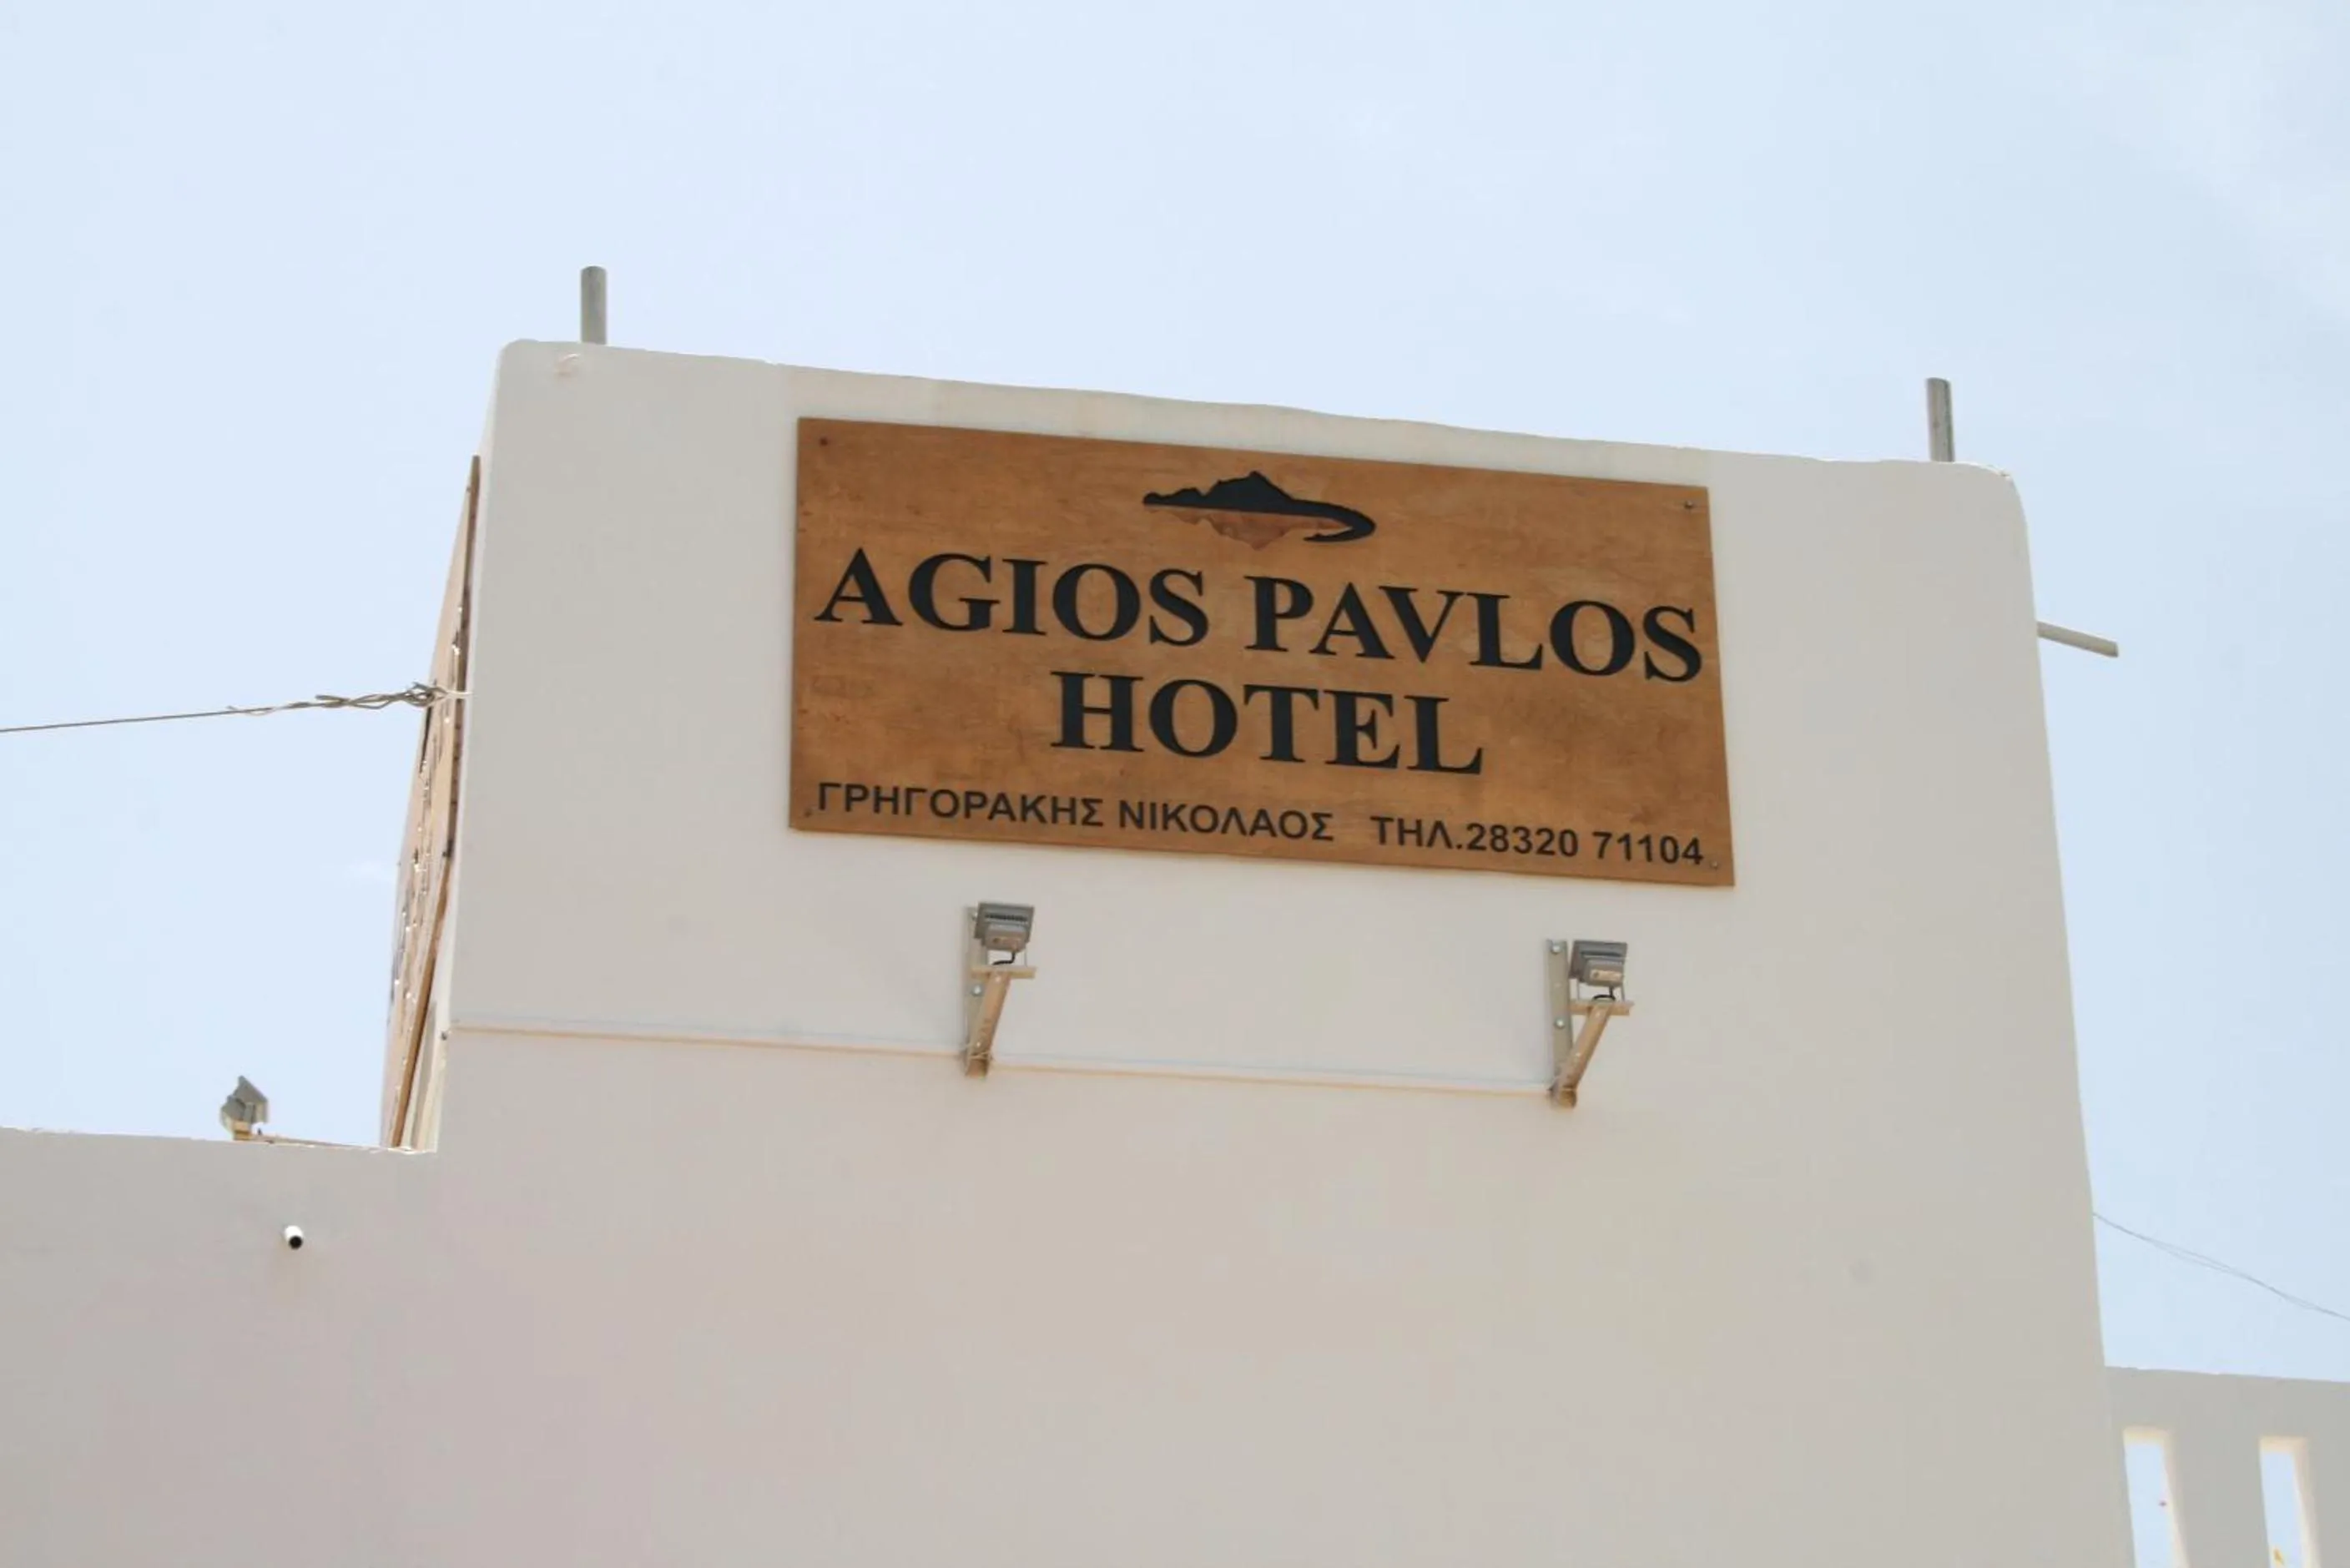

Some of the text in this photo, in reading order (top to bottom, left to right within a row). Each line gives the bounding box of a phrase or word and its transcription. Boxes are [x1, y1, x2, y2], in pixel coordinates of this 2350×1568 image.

[814, 547, 1702, 683] AGIOS PAVLOS
[1050, 670, 1483, 775] HOTEL
[818, 782, 1104, 827] ΓΡΗΓΟΡΑΚΗΣ
[1118, 799, 1334, 841] ΝΙΚΟΛΑΟΣ
[1592, 831, 1704, 865] 71104
